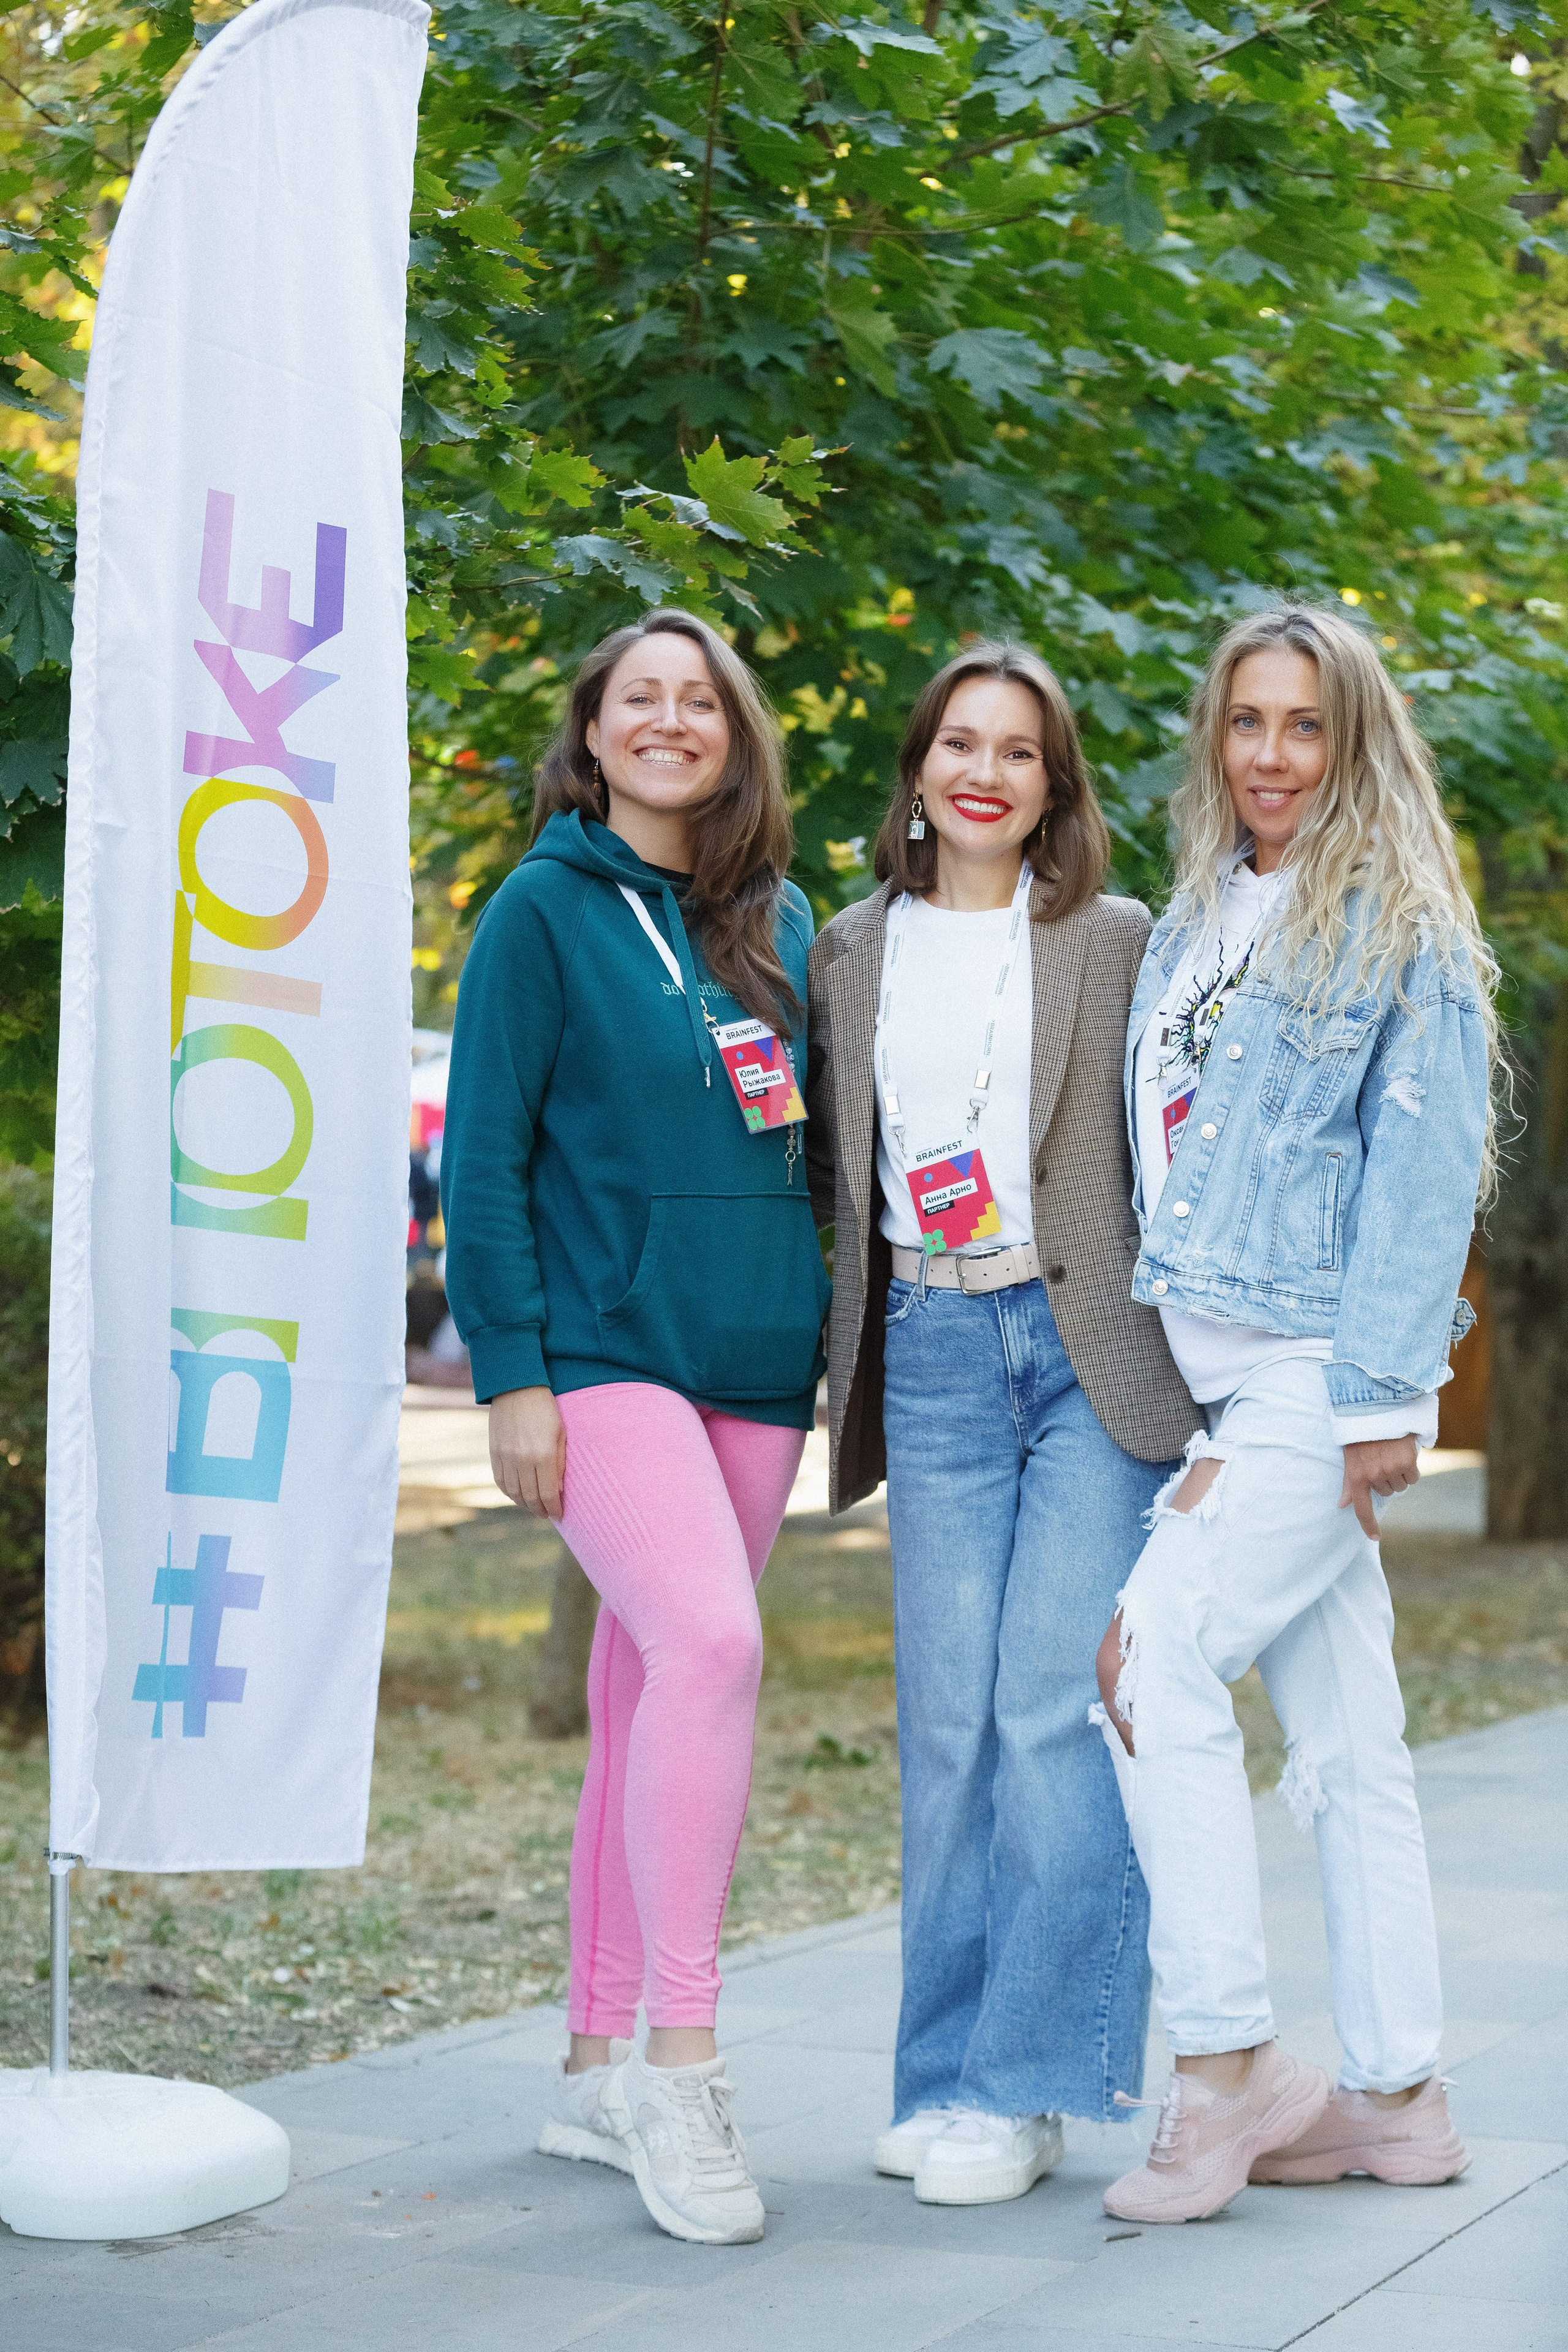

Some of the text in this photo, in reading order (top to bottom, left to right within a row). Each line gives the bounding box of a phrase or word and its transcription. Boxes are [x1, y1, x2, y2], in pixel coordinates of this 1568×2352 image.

[660, 981, 742, 1000] do othin
[726, 1025, 763, 1040] BRAINFEST
[739, 1068, 760, 1079] Юлия
[742, 1073, 780, 1088] Рыжакова
[747, 1089, 765, 1098] ПАРТНЕР
[1167, 1077, 1191, 1098] BRAINFEST
[1170, 1125, 1184, 1138] Оксан
[916, 1140, 962, 1162] BRAINFEST
[925, 1184, 971, 1205] Анна Арно
[927, 1202, 950, 1214] ПАРТНЕР
